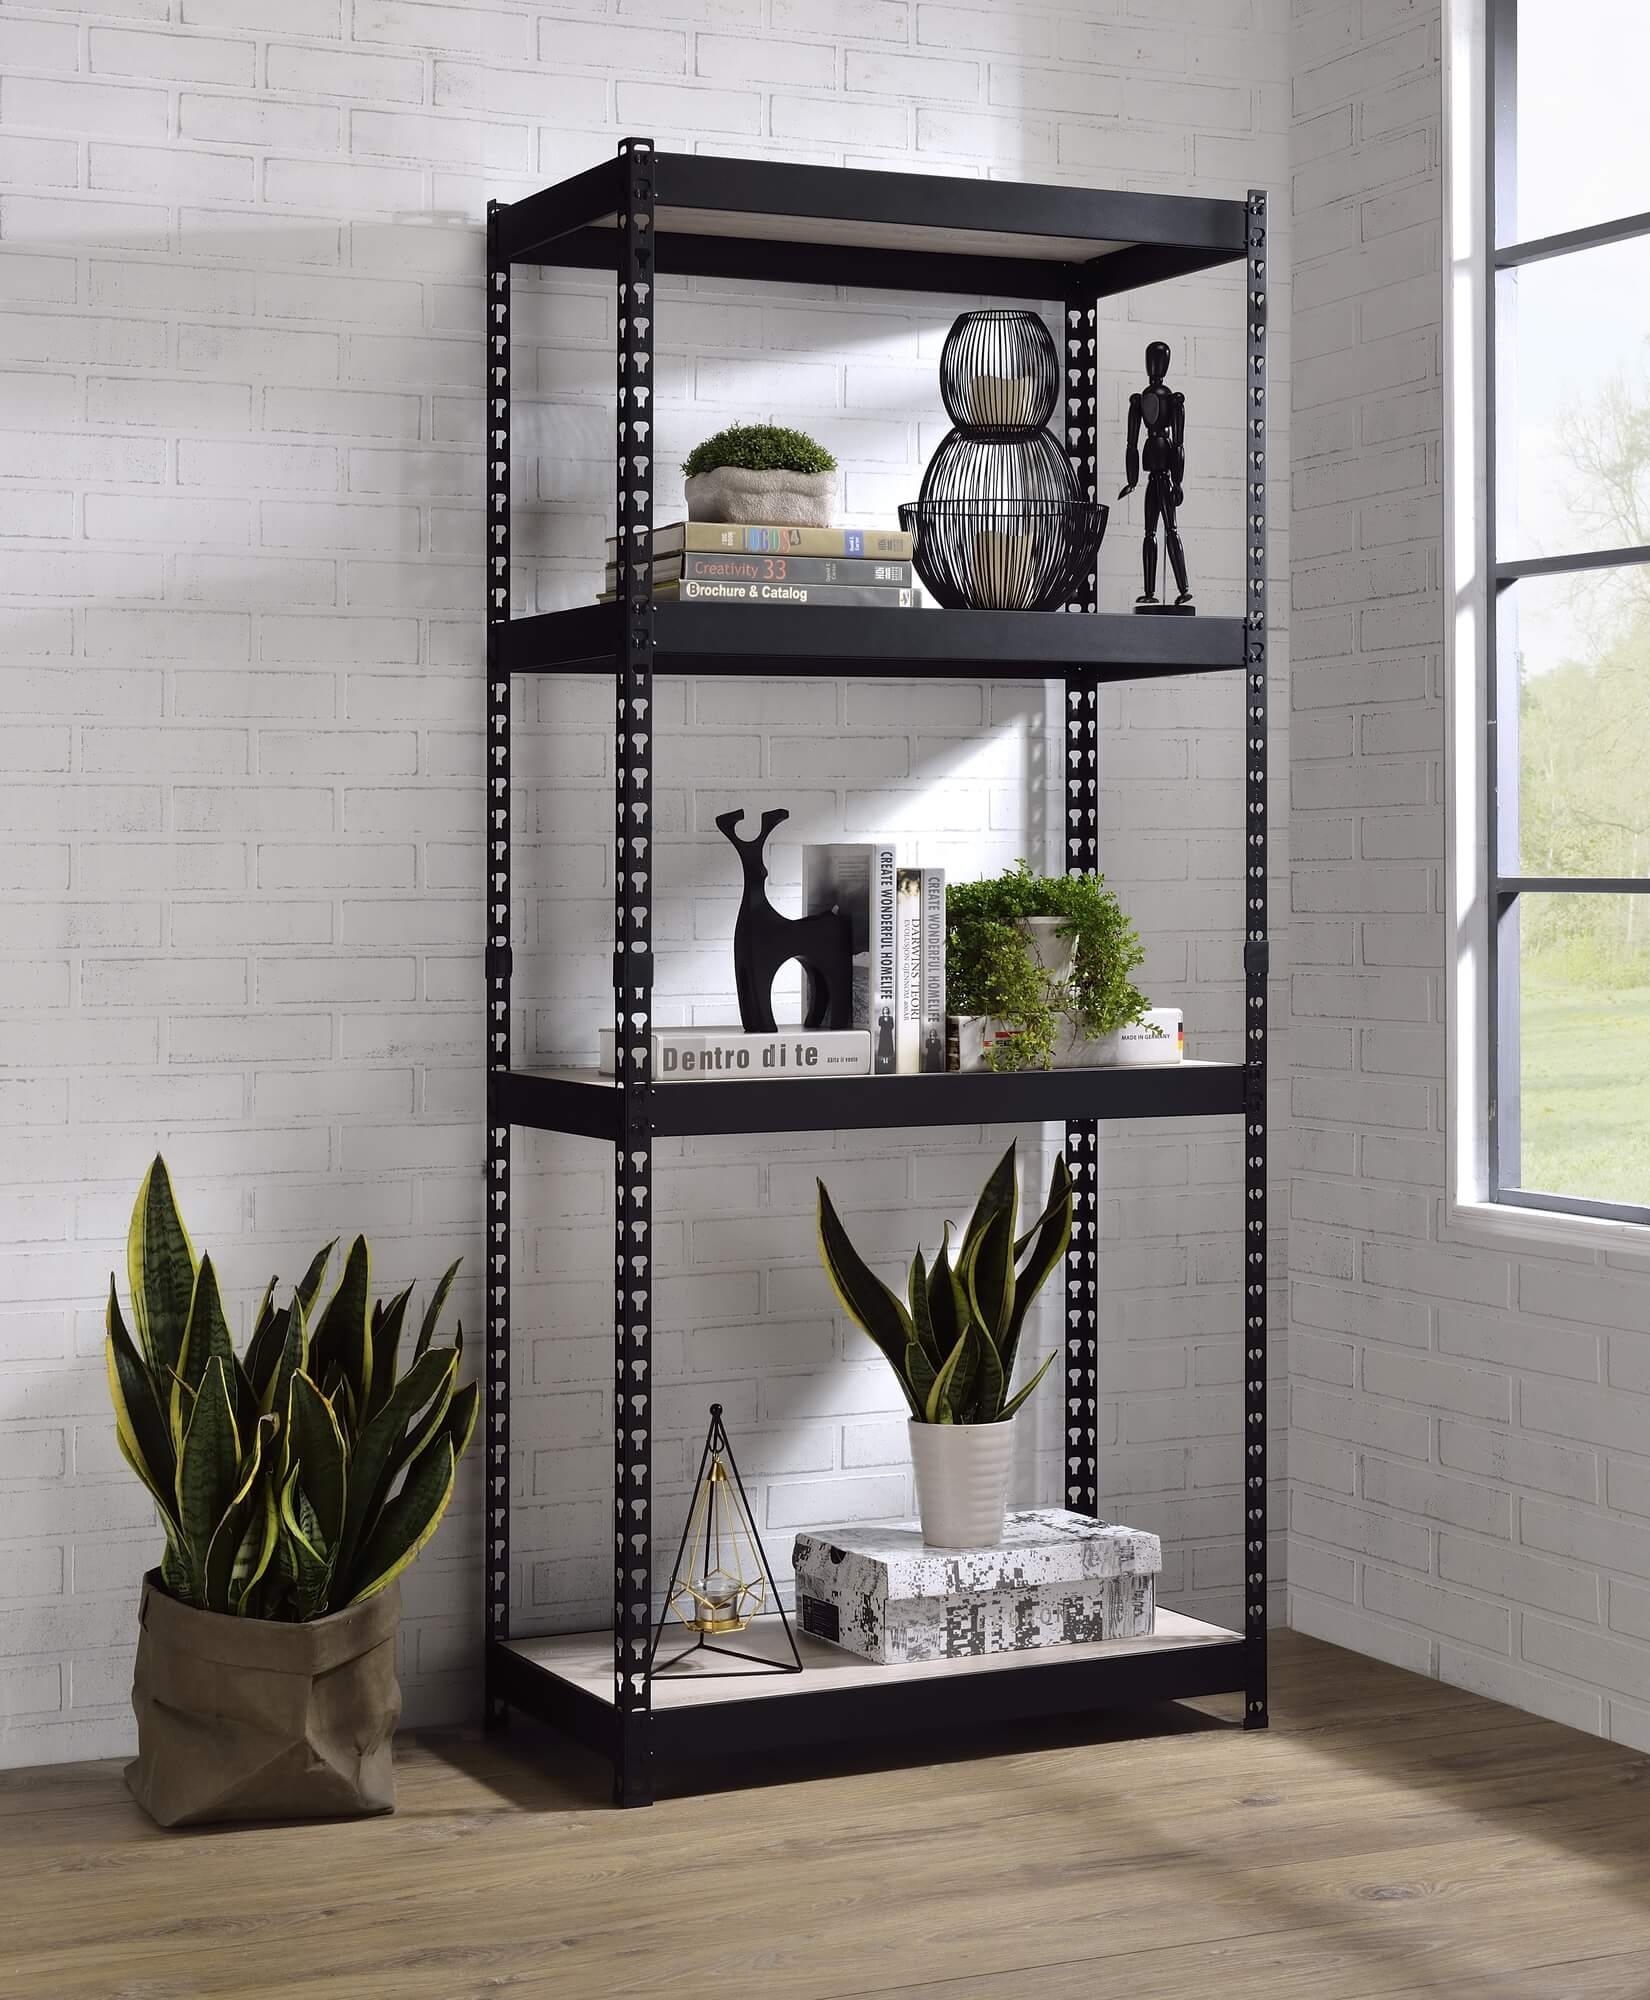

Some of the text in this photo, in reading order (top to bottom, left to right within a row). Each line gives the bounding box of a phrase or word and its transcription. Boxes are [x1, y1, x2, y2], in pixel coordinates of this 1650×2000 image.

[686, 581, 808, 602] Brochure & Catalog
[694, 559, 787, 580] Creativity 33
[880, 851, 893, 1000] CREATE WONDERFUL HOMELIFE
[927, 876, 940, 1023] CREATE WONDERFUL HOMELIFE
[911, 918, 921, 1021] DARWINS TEORI
[662, 1043, 818, 1072] Dentro di te
